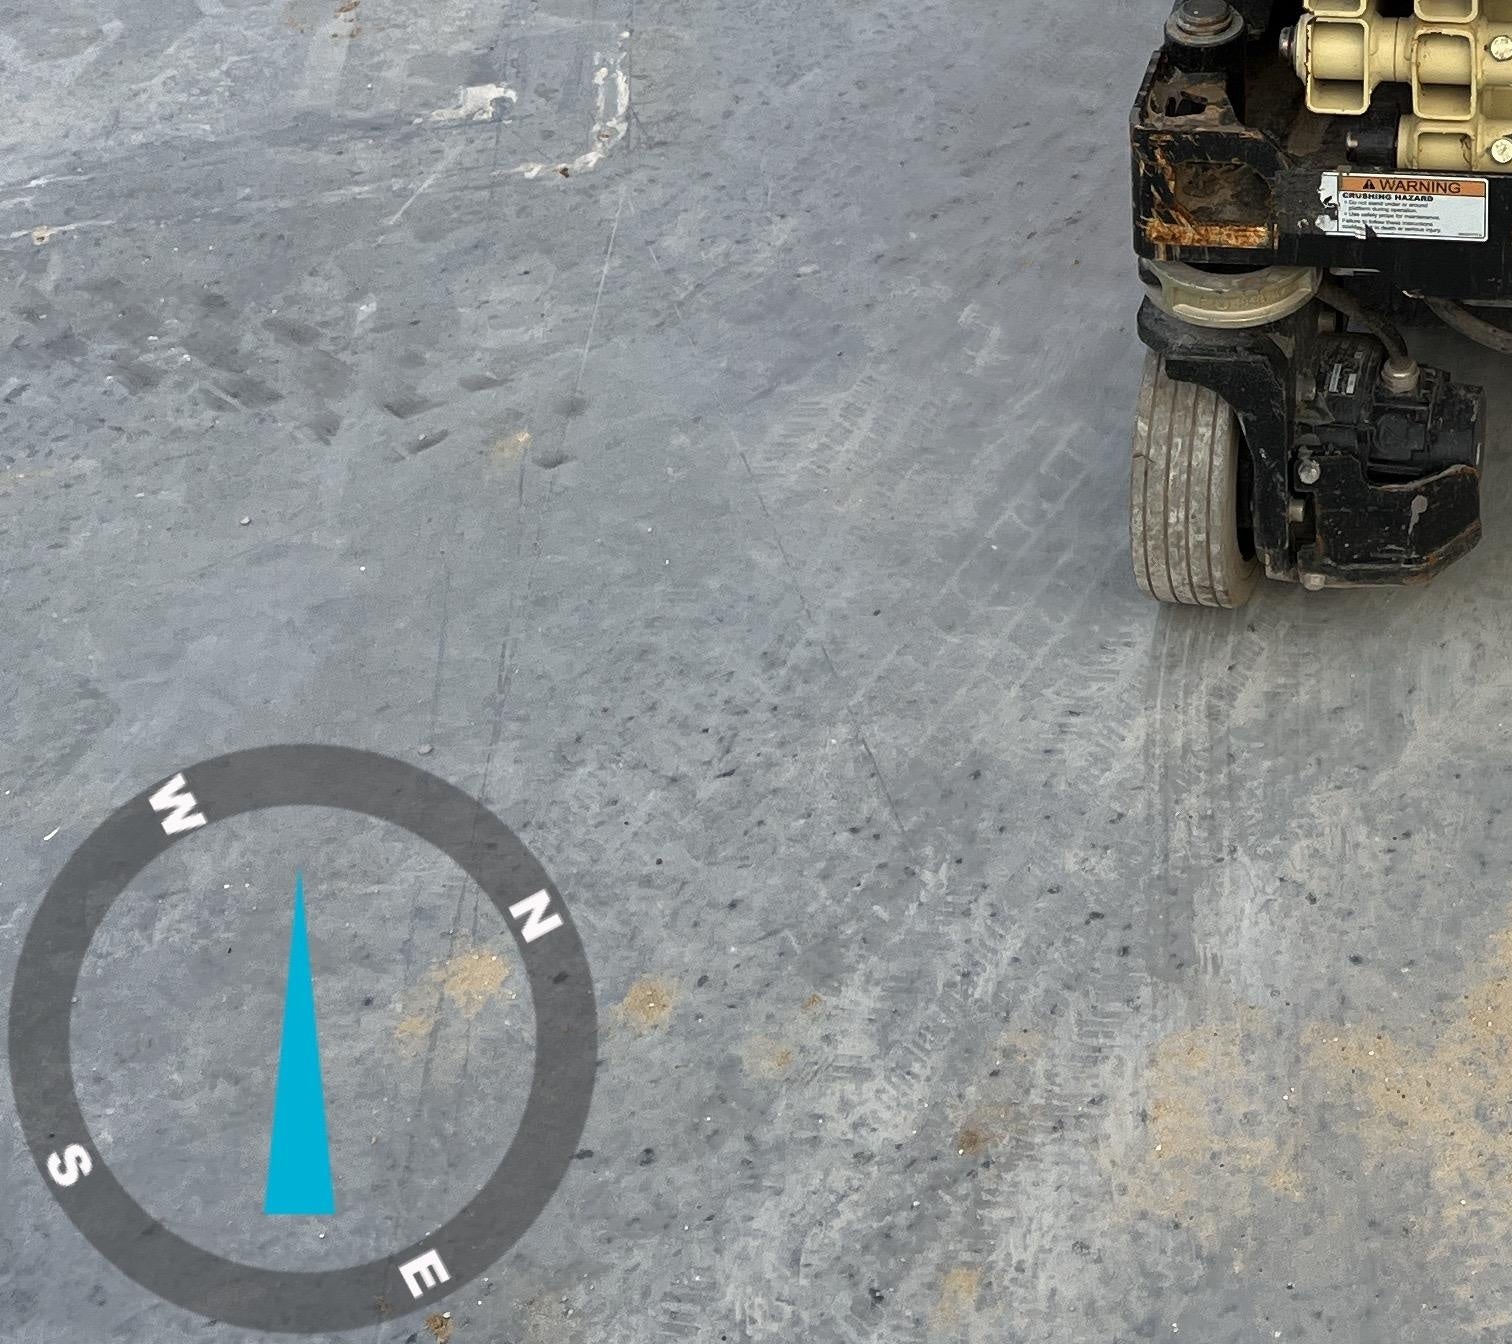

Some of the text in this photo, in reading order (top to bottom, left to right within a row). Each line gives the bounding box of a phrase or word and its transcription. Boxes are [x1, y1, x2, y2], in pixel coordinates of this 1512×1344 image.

[1379, 178, 1462, 194] WARNING
[1342, 192, 1434, 202] CRUSHING HAZARD
